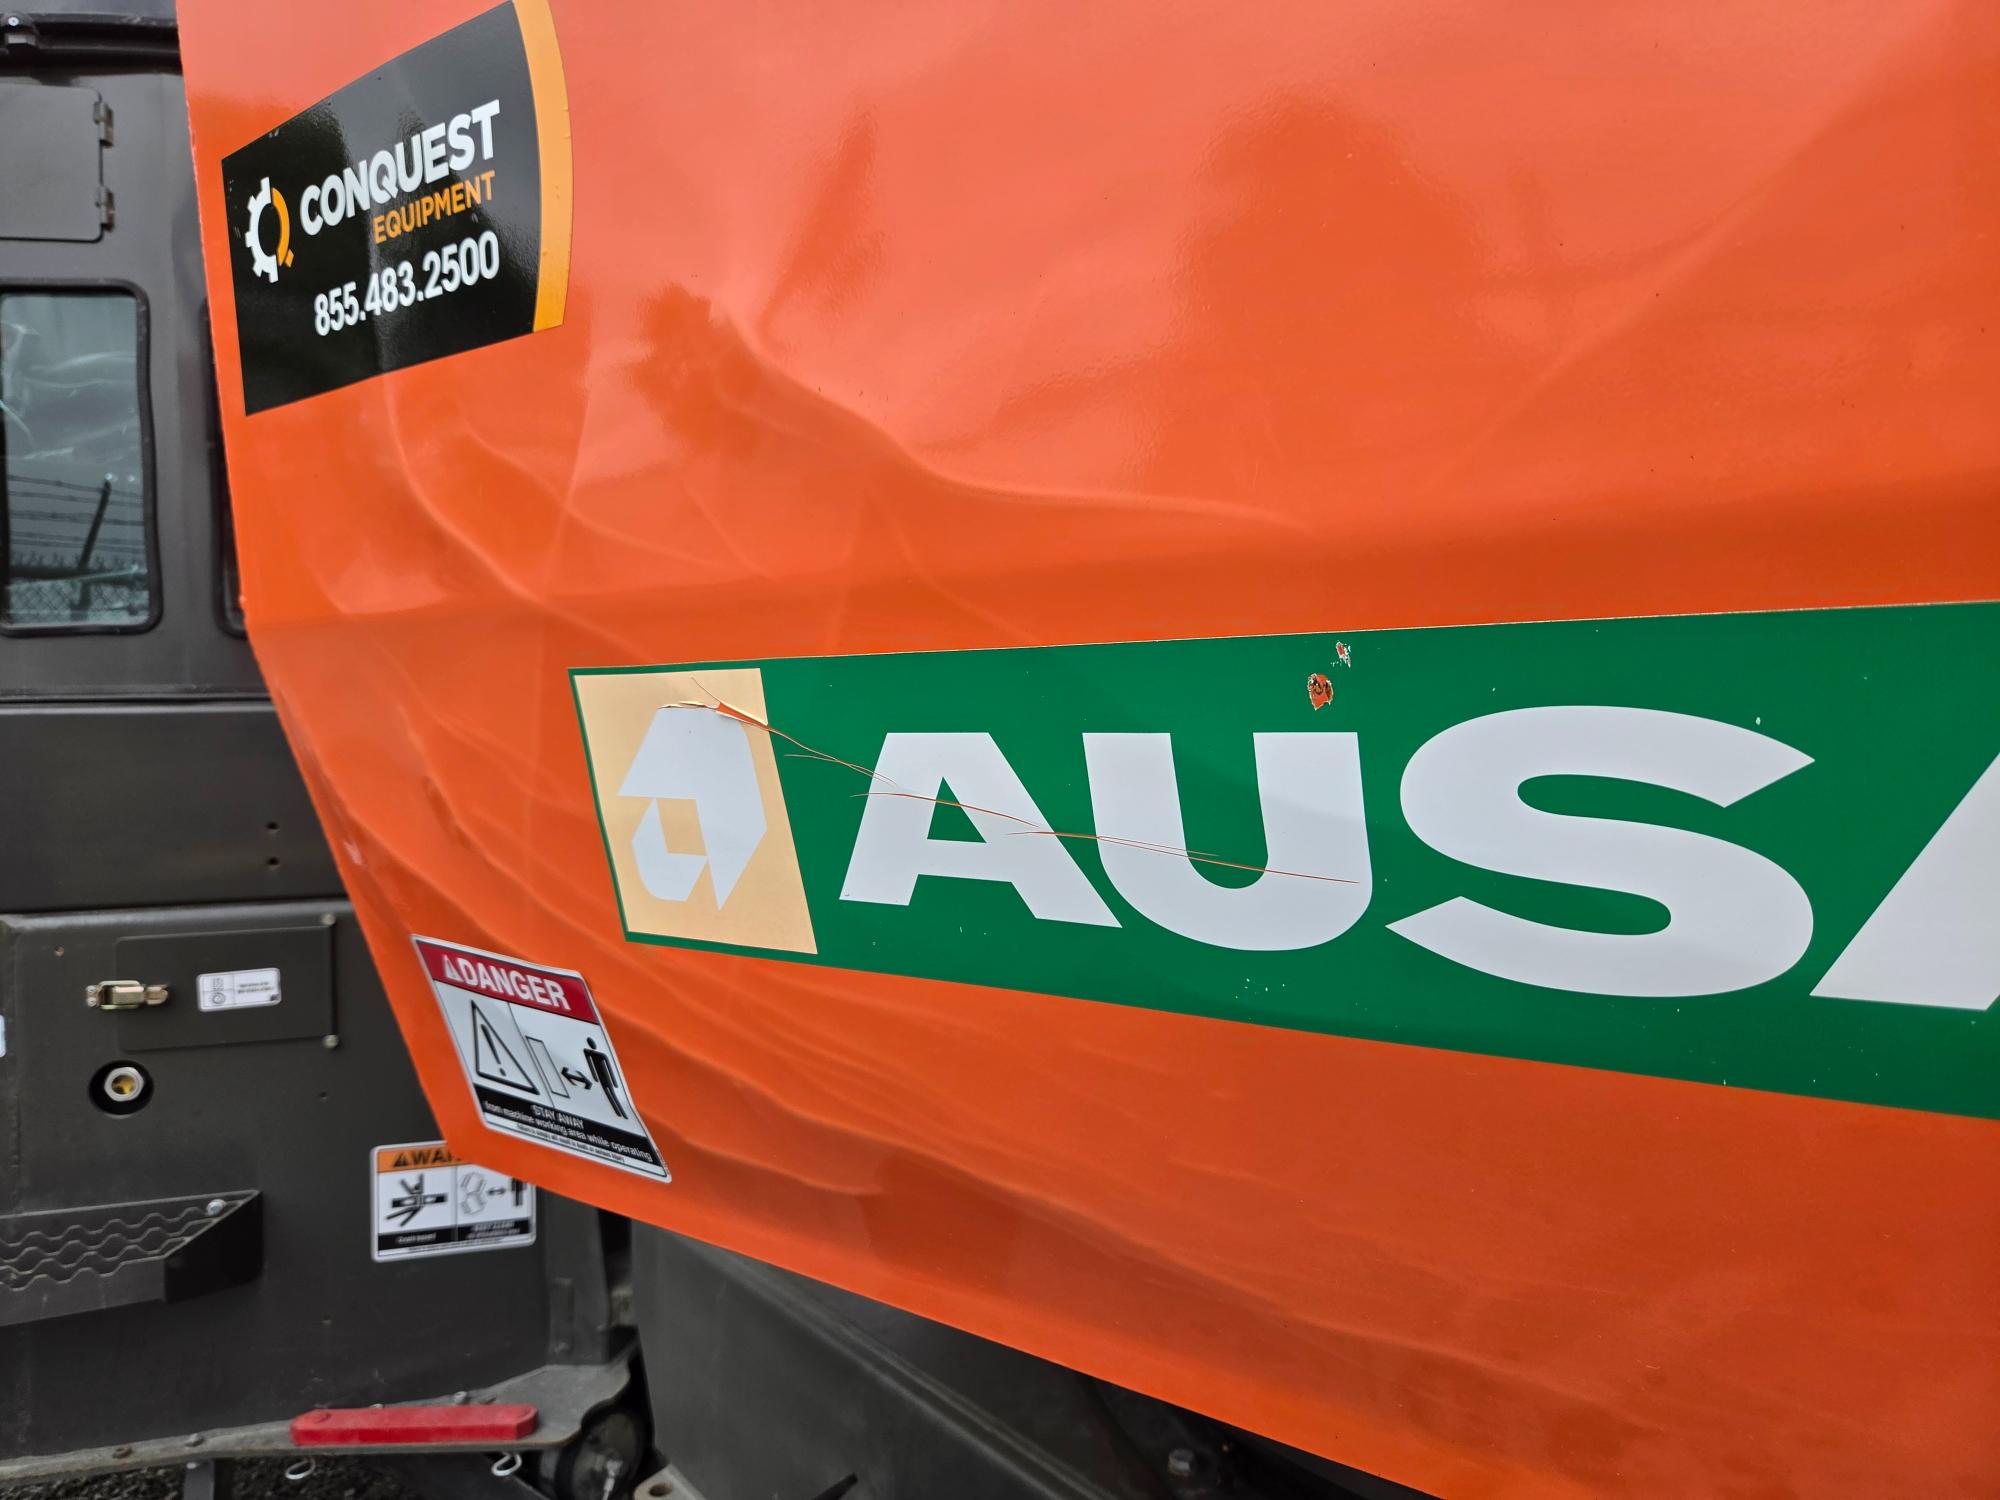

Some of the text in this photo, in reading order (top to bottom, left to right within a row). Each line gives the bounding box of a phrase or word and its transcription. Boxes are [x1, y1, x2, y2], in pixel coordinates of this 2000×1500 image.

[301, 99, 500, 236] CONQUEST
[373, 170, 496, 244] EQUIPMENT
[314, 230, 500, 336] 855.483.2500
[457, 957, 571, 1011] DANGER
[531, 1104, 584, 1130] STAY AWAY
[535, 1117, 567, 1136] working
[568, 1128, 586, 1140] area
[587, 1132, 610, 1148] while
[611, 1141, 653, 1162] operating
